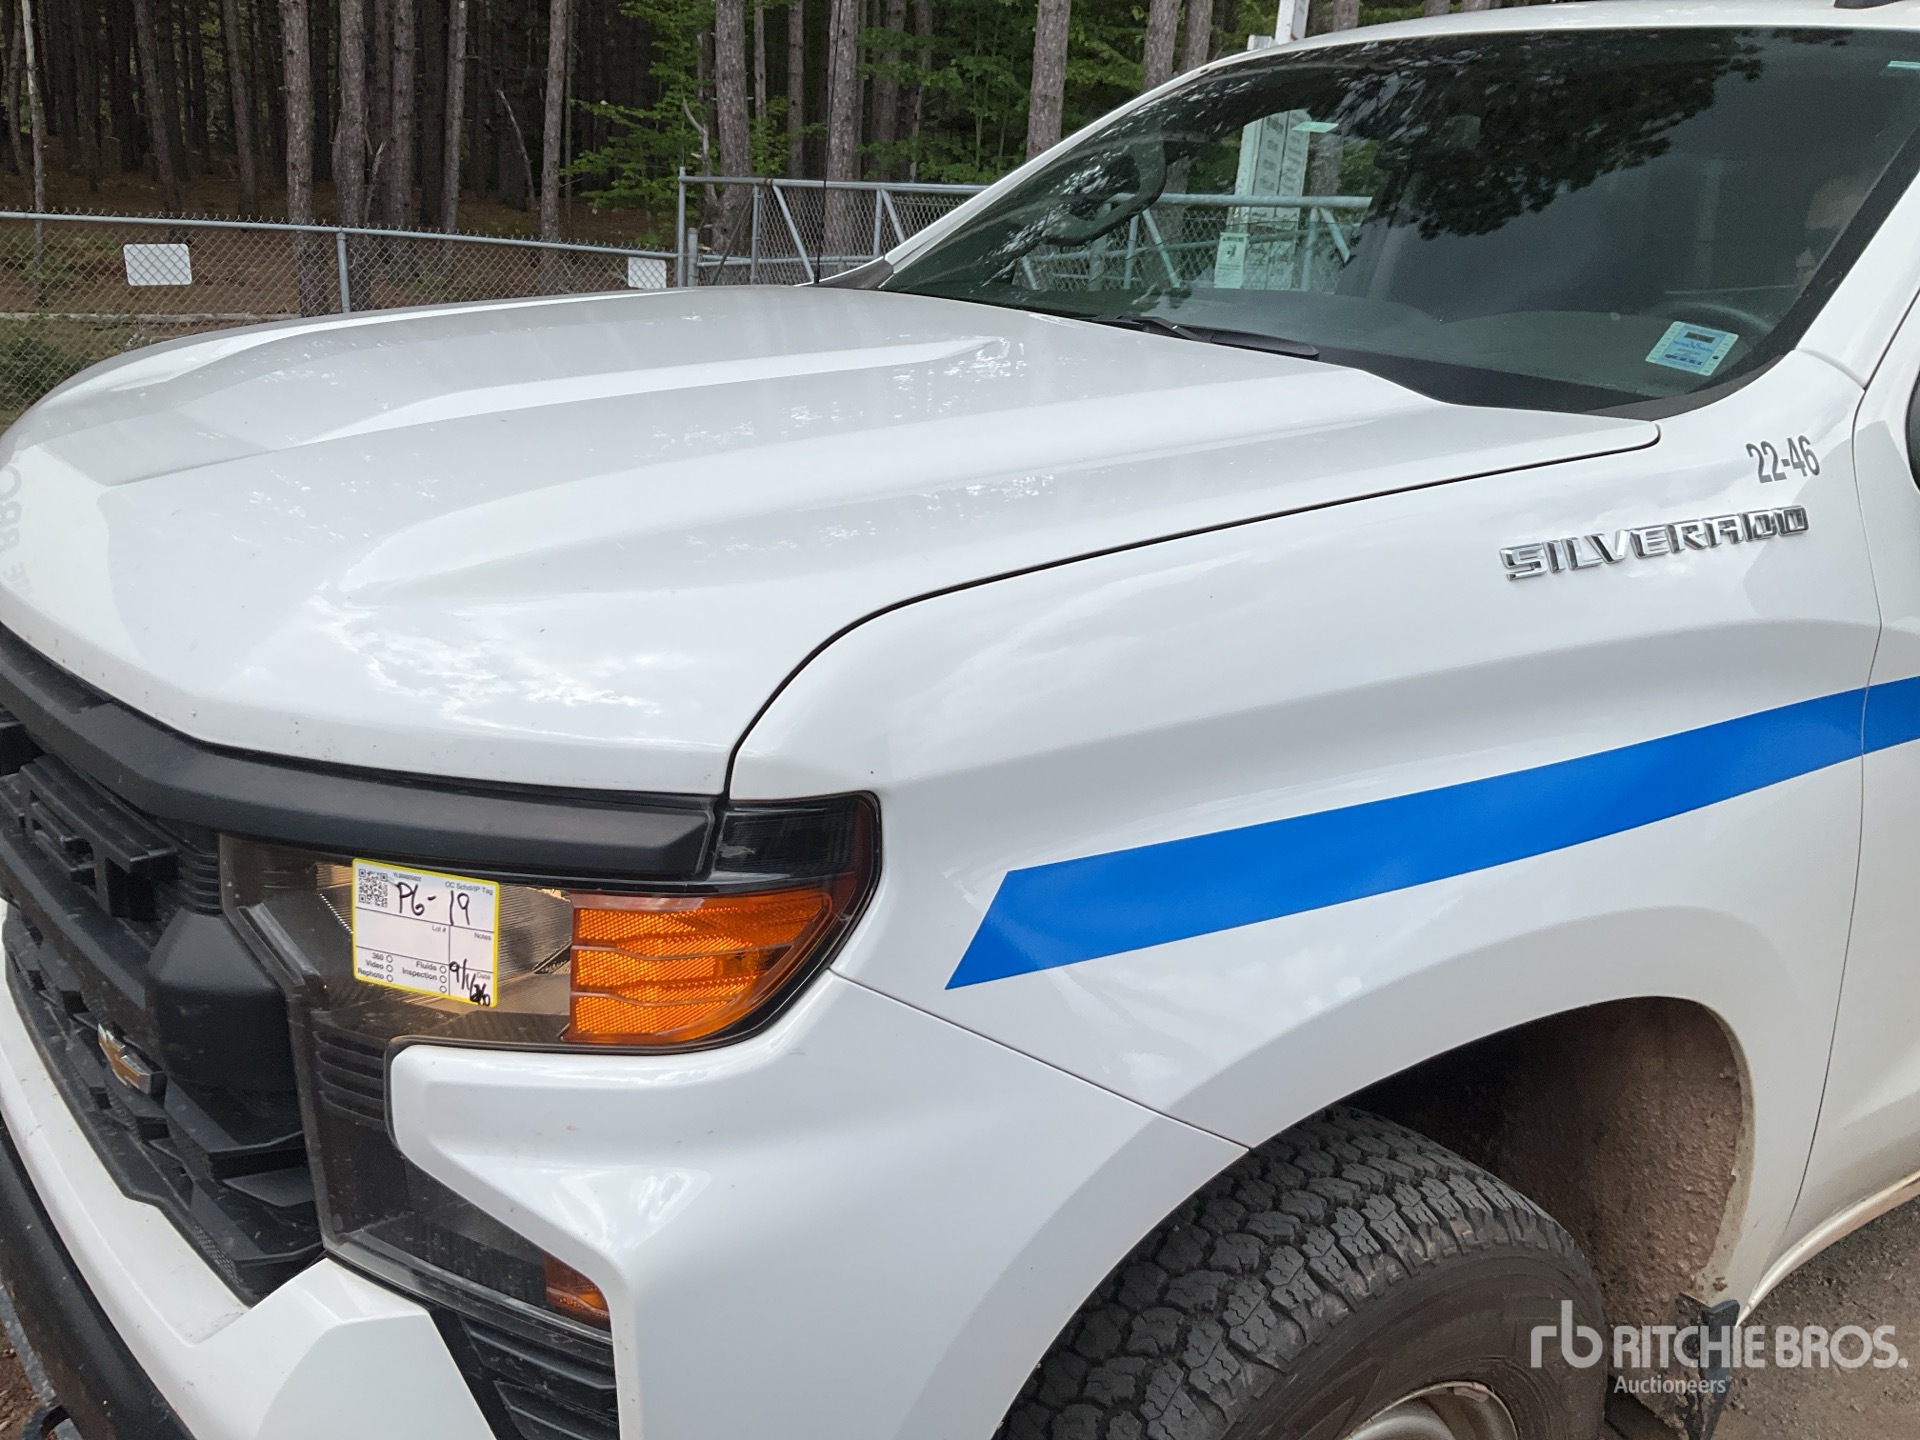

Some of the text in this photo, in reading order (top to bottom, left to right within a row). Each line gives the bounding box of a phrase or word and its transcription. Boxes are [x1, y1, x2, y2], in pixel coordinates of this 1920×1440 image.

[1745, 435, 1820, 484] 22-46
[1499, 505, 1809, 581] SILVERADO
[482, 886, 493, 896] Tag
[474, 932, 492, 941] Notes
[372, 952, 384, 961] 360
[365, 959, 384, 970] Video
[416, 961, 437, 971] Fluids
[357, 967, 385, 979] Rephoto
[402, 967, 438, 981] Inspection
[476, 972, 491, 980] Date
